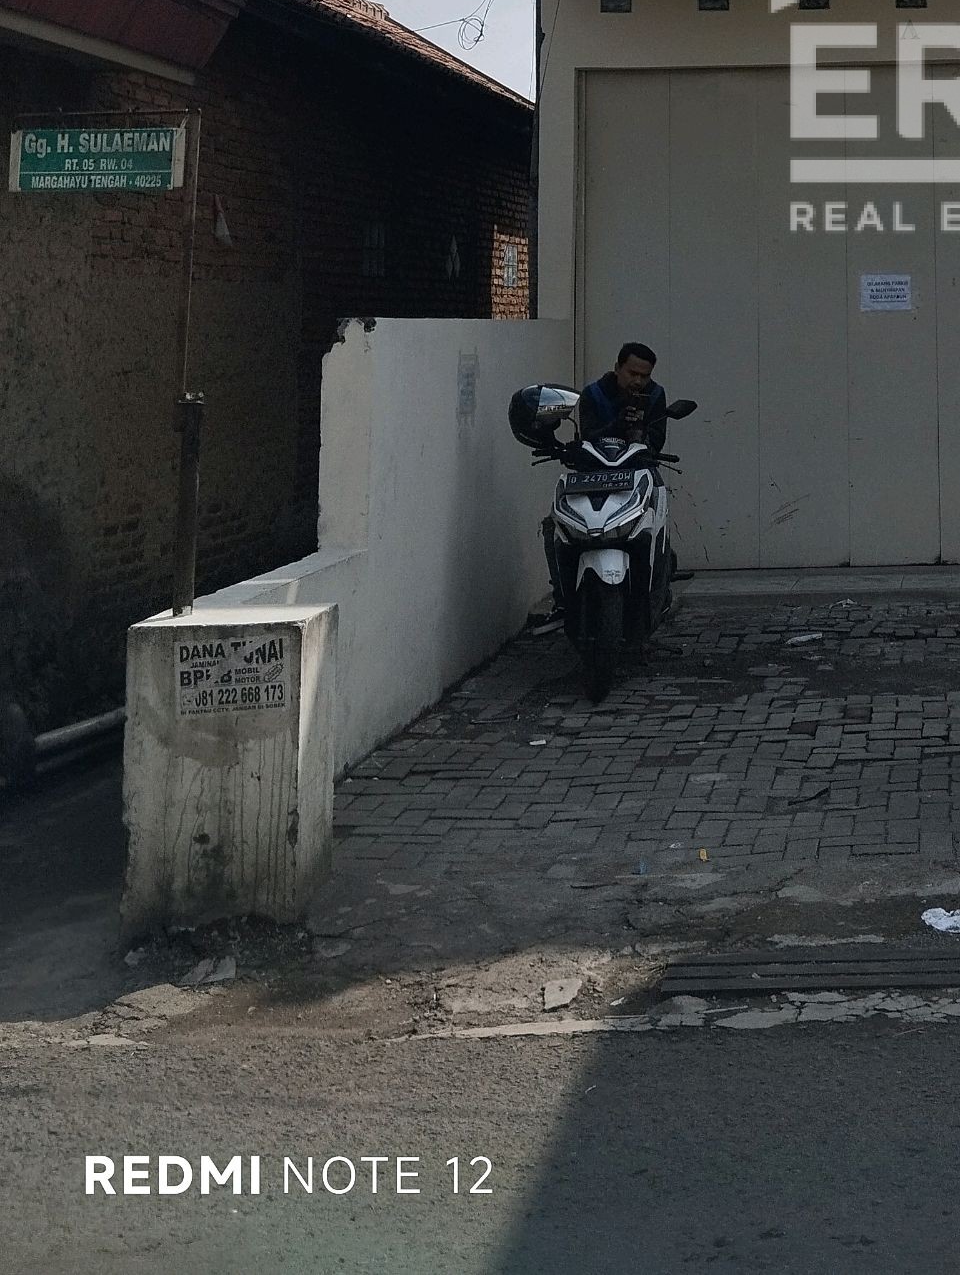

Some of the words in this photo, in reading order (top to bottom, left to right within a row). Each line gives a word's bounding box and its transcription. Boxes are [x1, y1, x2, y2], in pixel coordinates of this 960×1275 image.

[24, 133, 52, 158] Gg.
[57, 133, 73, 153] H.
[79, 132, 171, 153] SULAEMAN
[65, 158, 79, 171] RT.
[83, 158, 95, 170] 05
[100, 158, 118, 170] RW.
[121, 158, 133, 170] 04
[31, 176, 88, 189] MARGAHAYU
[90, 175, 127, 188] TENGAH
[134, 175, 162, 188] 40225
[179, 642, 226, 663] DANA
[235, 667, 260, 676] MOBIL
[235, 677, 261, 685] MOTOR
[218, 687, 238, 705] 222
[241, 685, 261, 704] 668
[264, 683, 284, 702] 173
